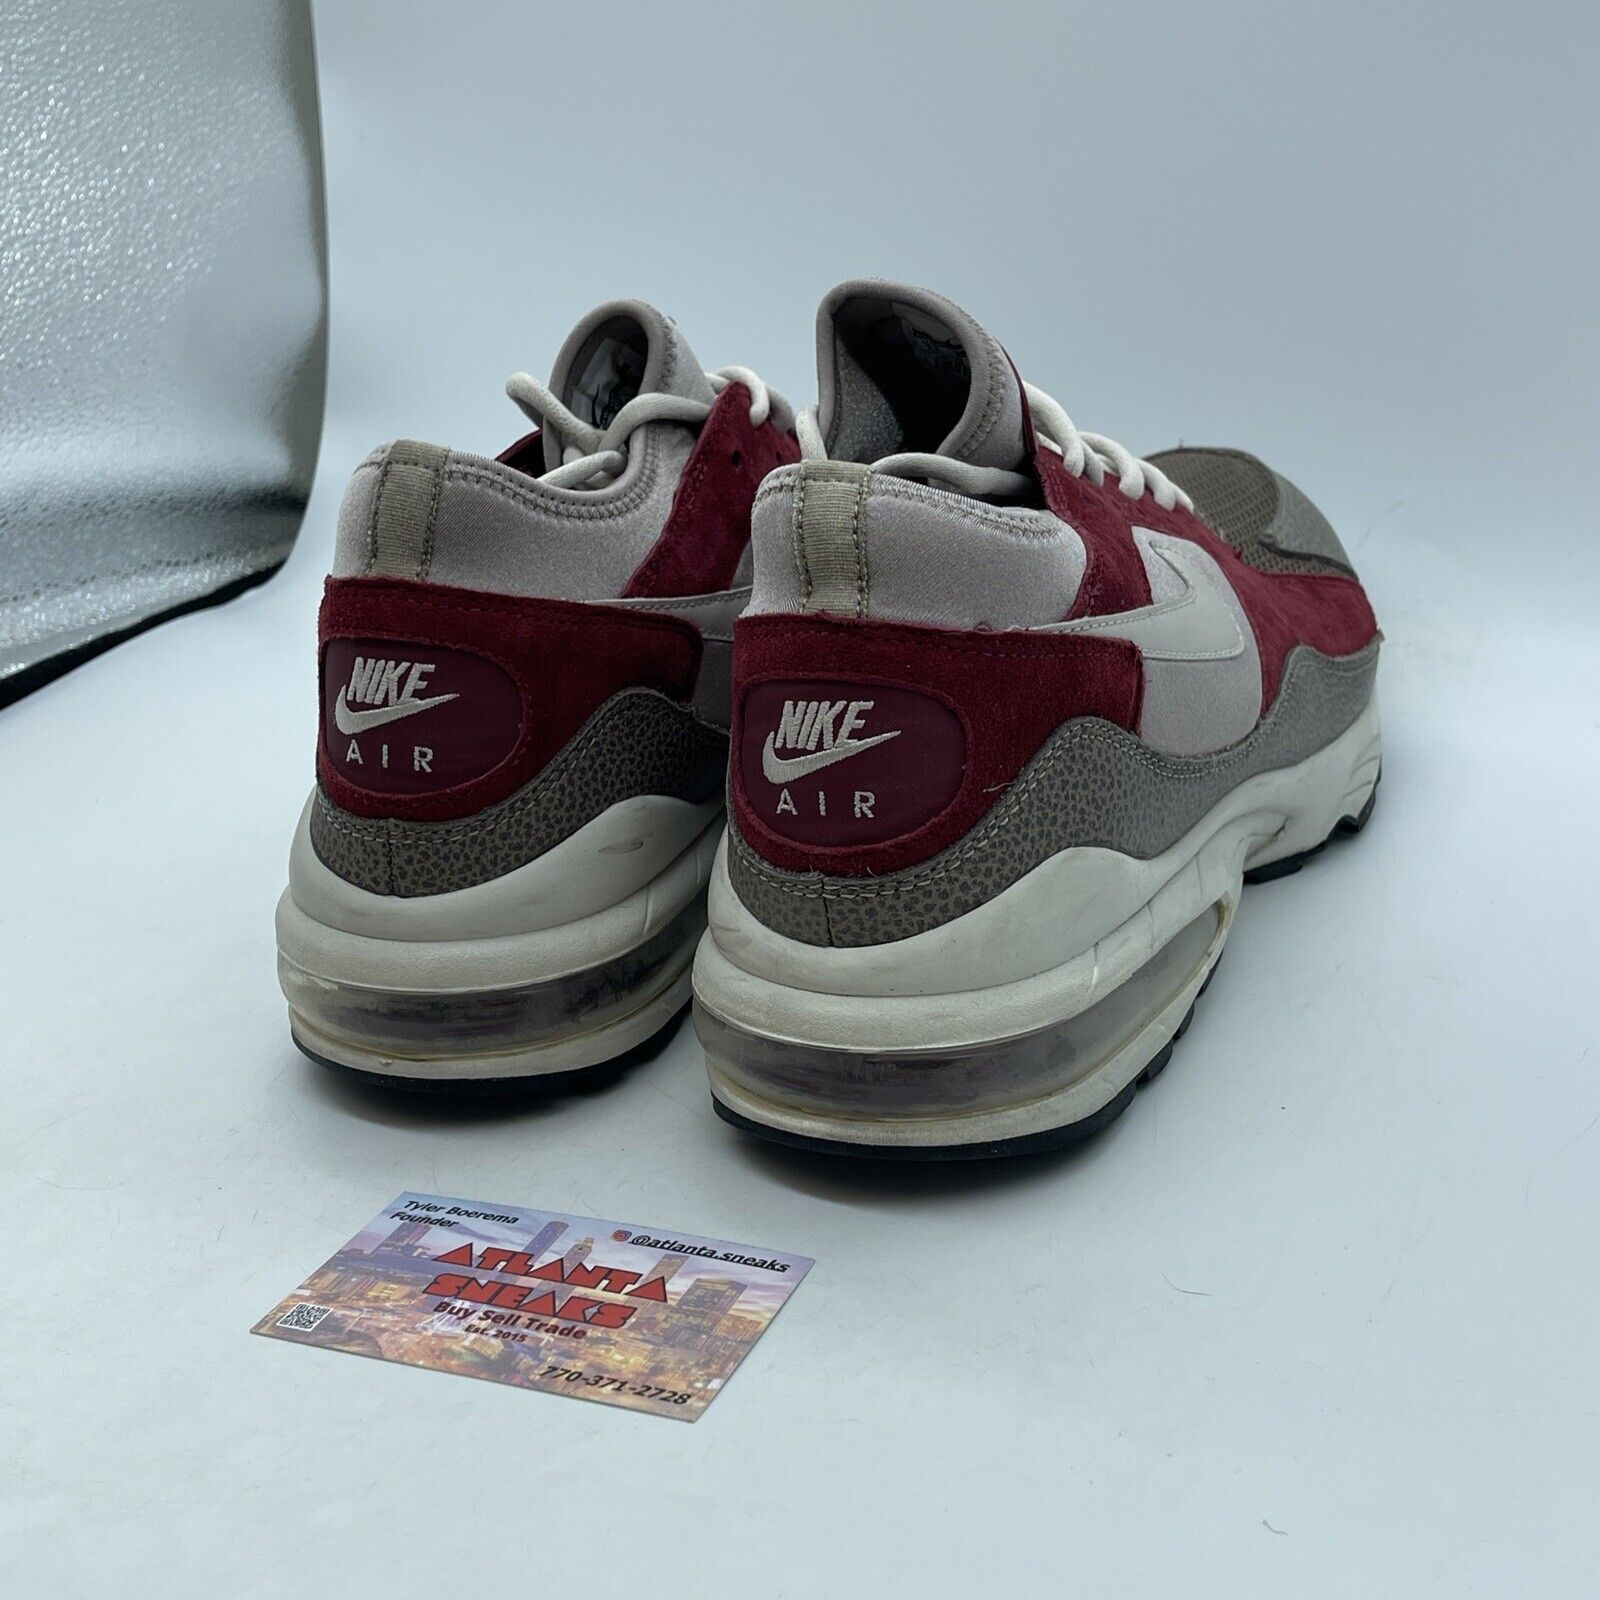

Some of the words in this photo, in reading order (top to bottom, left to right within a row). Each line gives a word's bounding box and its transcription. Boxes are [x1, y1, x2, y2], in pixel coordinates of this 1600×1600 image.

[347, 656, 436, 706] NIKE
[774, 700, 875, 750] NIKE
[345, 739, 434, 772] AIR
[776, 788, 876, 818] AIR
[390, 1211, 460, 1228] Founder
[404, 1200, 446, 1213] Tyler
[445, 1206, 520, 1225] Boerema
[431, 1241, 668, 1303] ATLANTA
[629, 1234, 792, 1273] @atlanta.sneaks
[421, 1272, 638, 1329] SNEAKS
[433, 1301, 475, 1322] Buy
[478, 1309, 521, 1327] Sell
[523, 1316, 588, 1340] Trade
[464, 1323, 489, 1335] Est.
[492, 1329, 529, 1343] 2015
[539, 1365, 692, 1405] 770-371-2728
